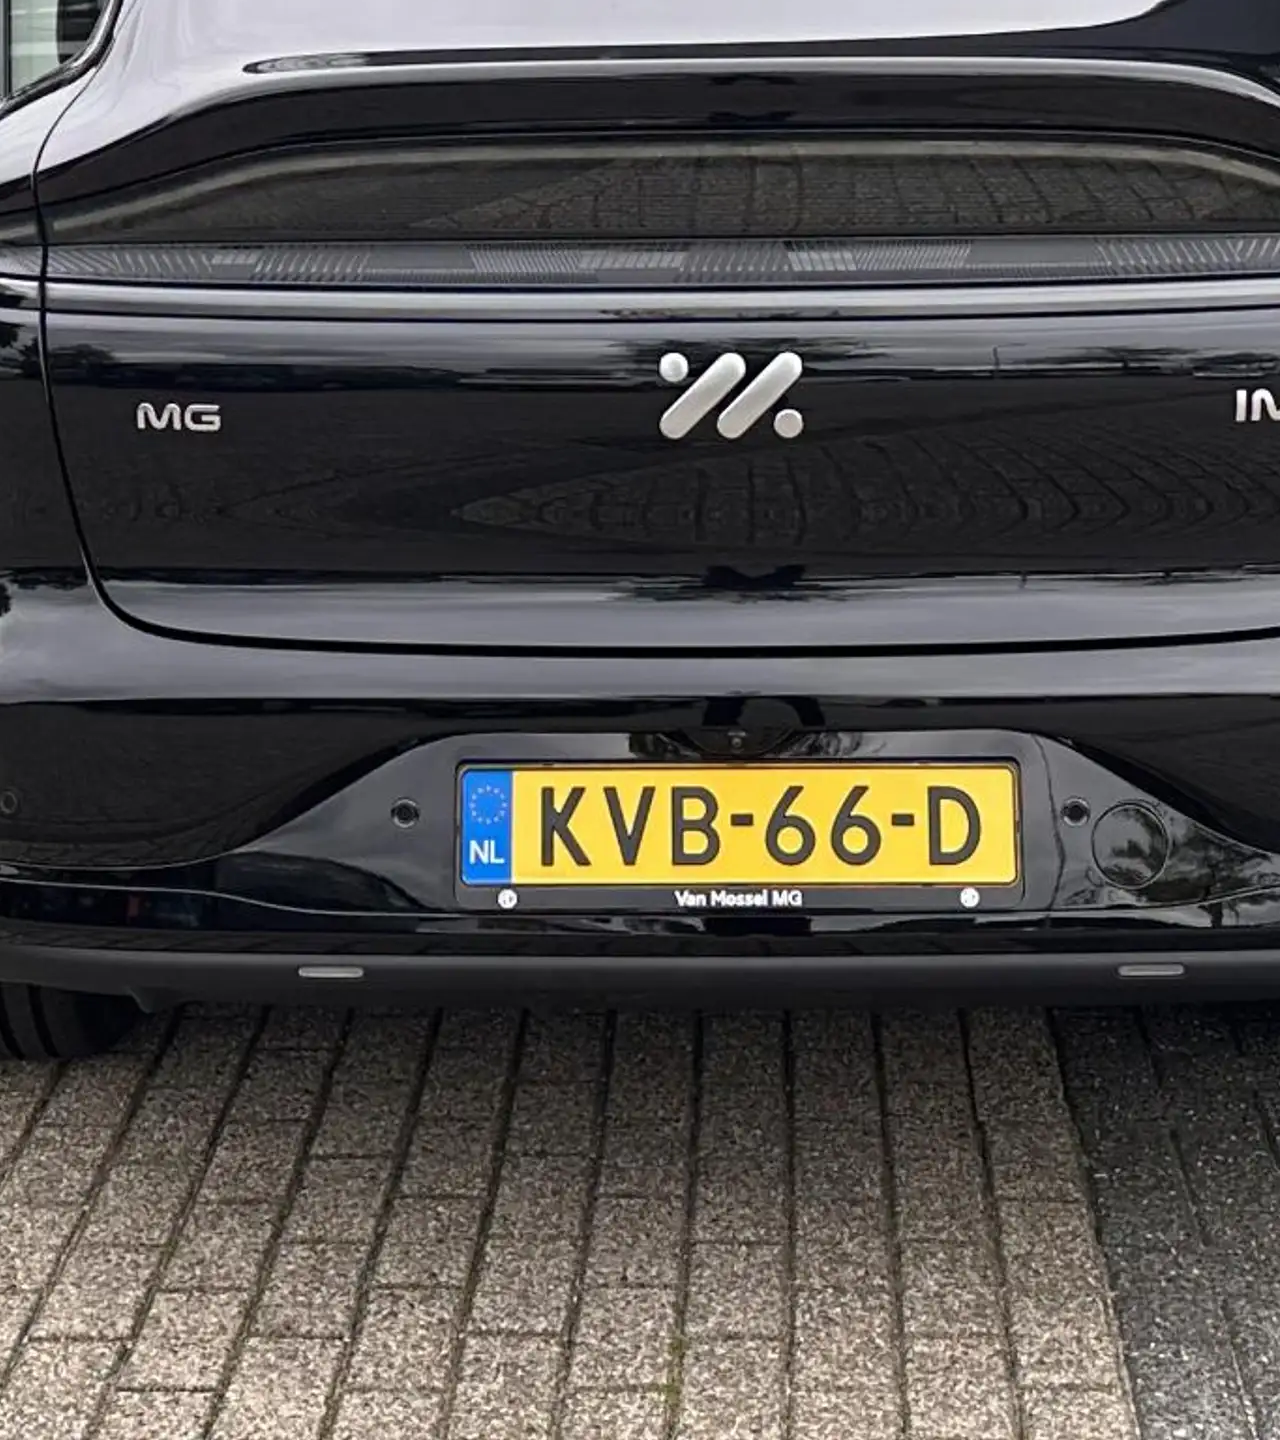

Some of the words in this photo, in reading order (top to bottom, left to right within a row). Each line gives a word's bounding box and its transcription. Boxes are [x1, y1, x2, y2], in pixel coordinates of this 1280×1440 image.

[136, 402, 221, 431] MG
[541, 785, 981, 867] KVB-66-D
[469, 840, 505, 865] NL
[674, 889, 707, 907] Van
[710, 888, 768, 907] Mossel
[772, 889, 803, 907] MG
